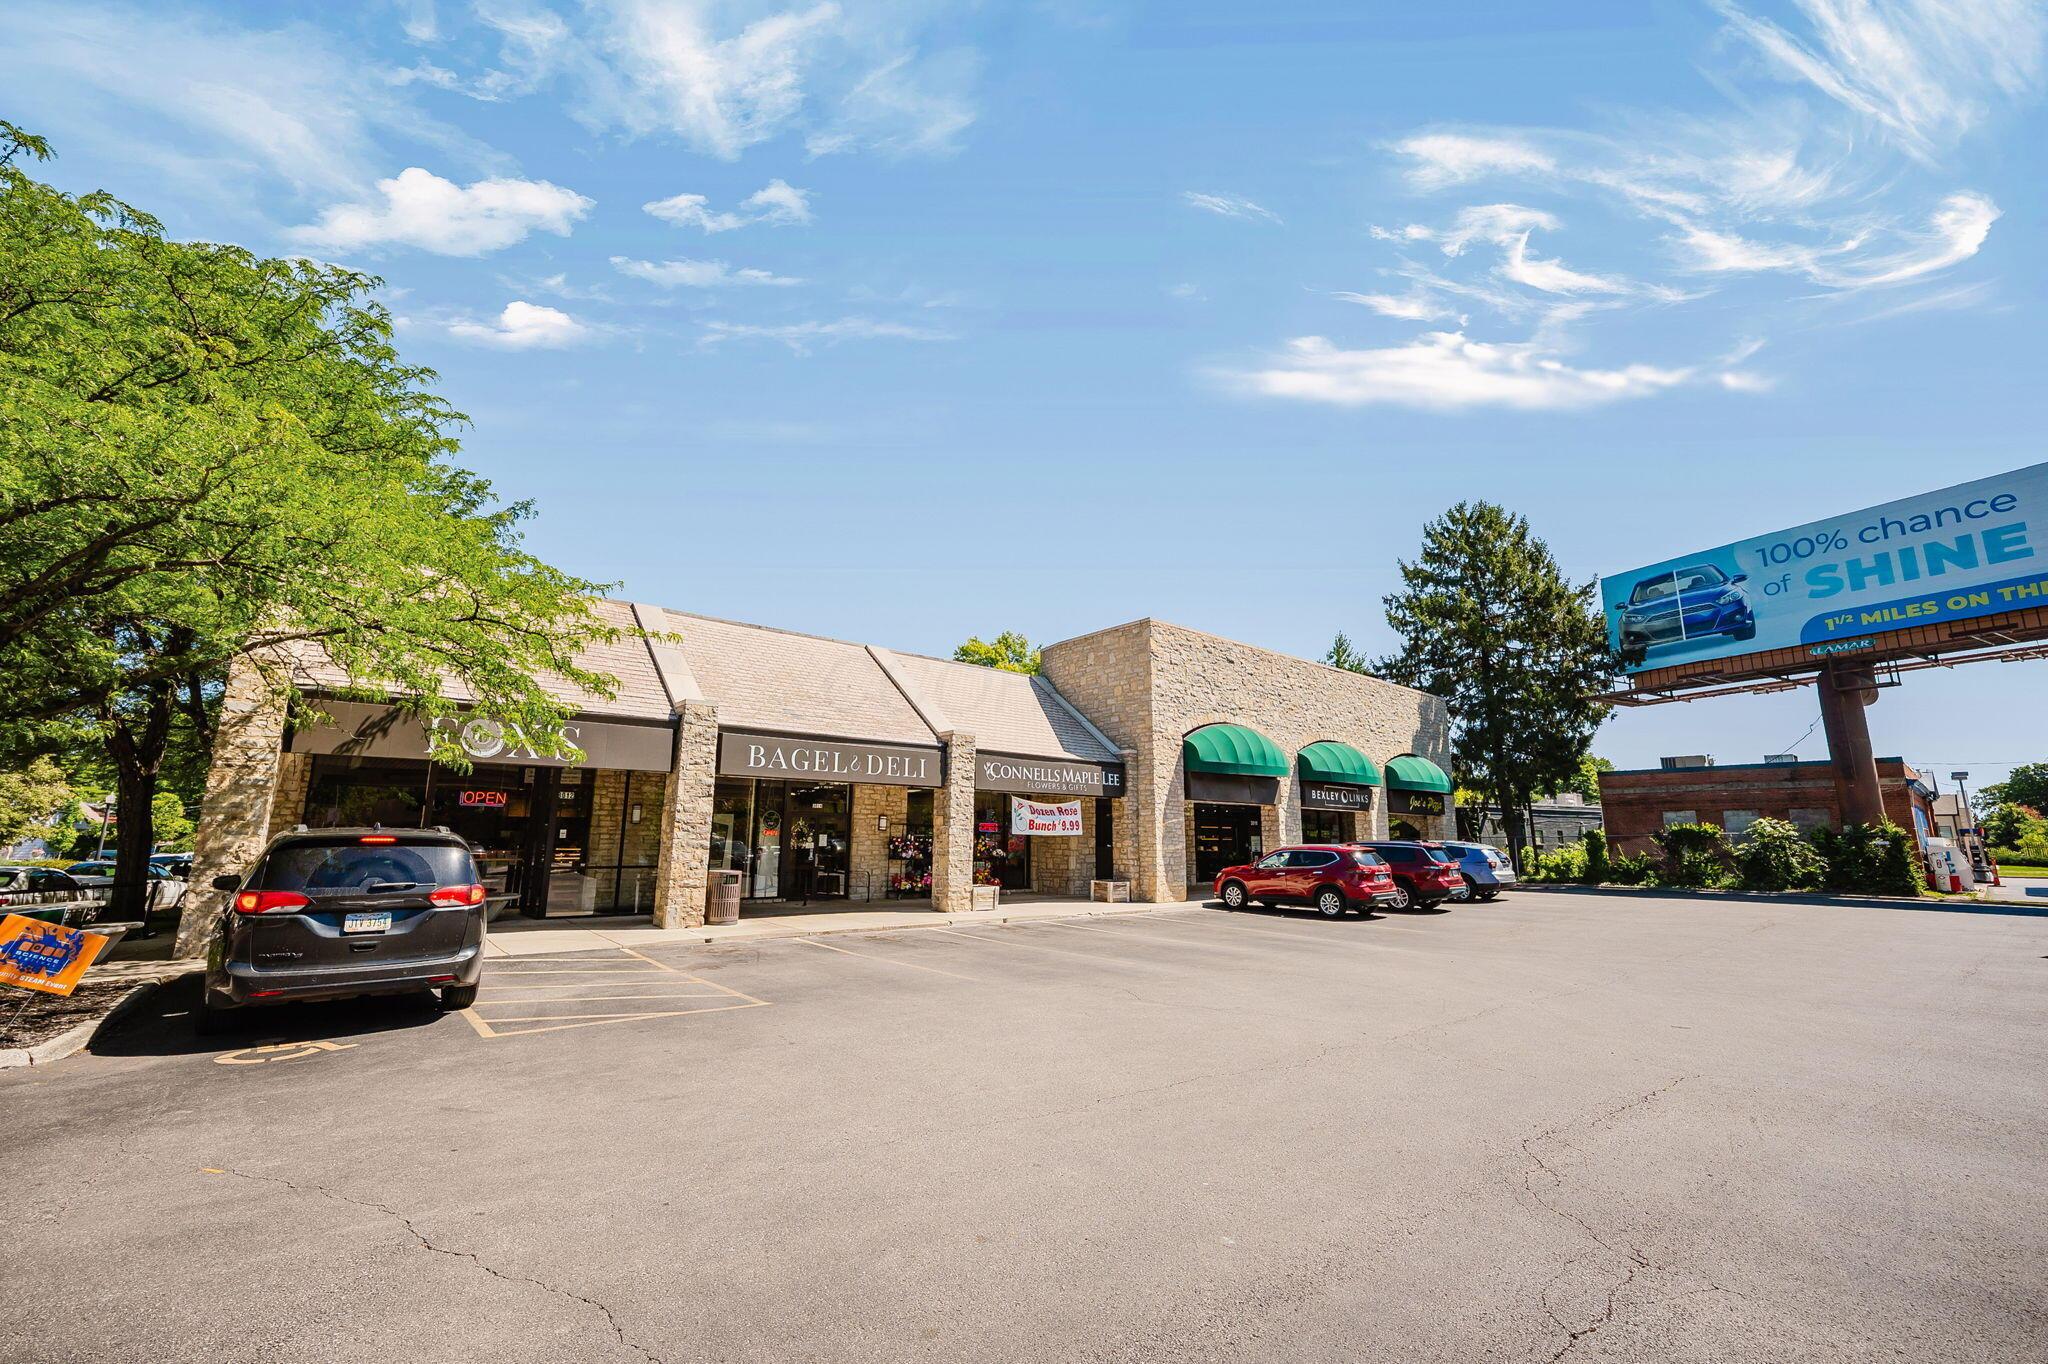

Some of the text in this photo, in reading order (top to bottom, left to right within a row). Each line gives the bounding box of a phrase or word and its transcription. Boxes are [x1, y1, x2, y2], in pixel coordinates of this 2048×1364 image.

[1756, 493, 2018, 567] 100% chance
[1763, 521, 2034, 599] of SHINE
[1861, 600, 1939, 626] MILES
[1946, 591, 1990, 610] ON
[1816, 640, 1871, 654] LAMAR
[748, 744, 926, 779] BAGEL & DELI
[990, 762, 1120, 786] CONNELLS MAPLE LEE
[1027, 782, 1061, 791] FLOWERS
[463, 791, 507, 804] OPEN
[1311, 789, 1369, 804] BEXLEY LINKS
[1028, 805, 1078, 816] Dozen Rose
[1028, 819, 1057, 831] Bunch
[15, 950, 60, 964] SCIENCE
[19, 975, 45, 985] STEAM
[45, 980, 68, 990] Event
